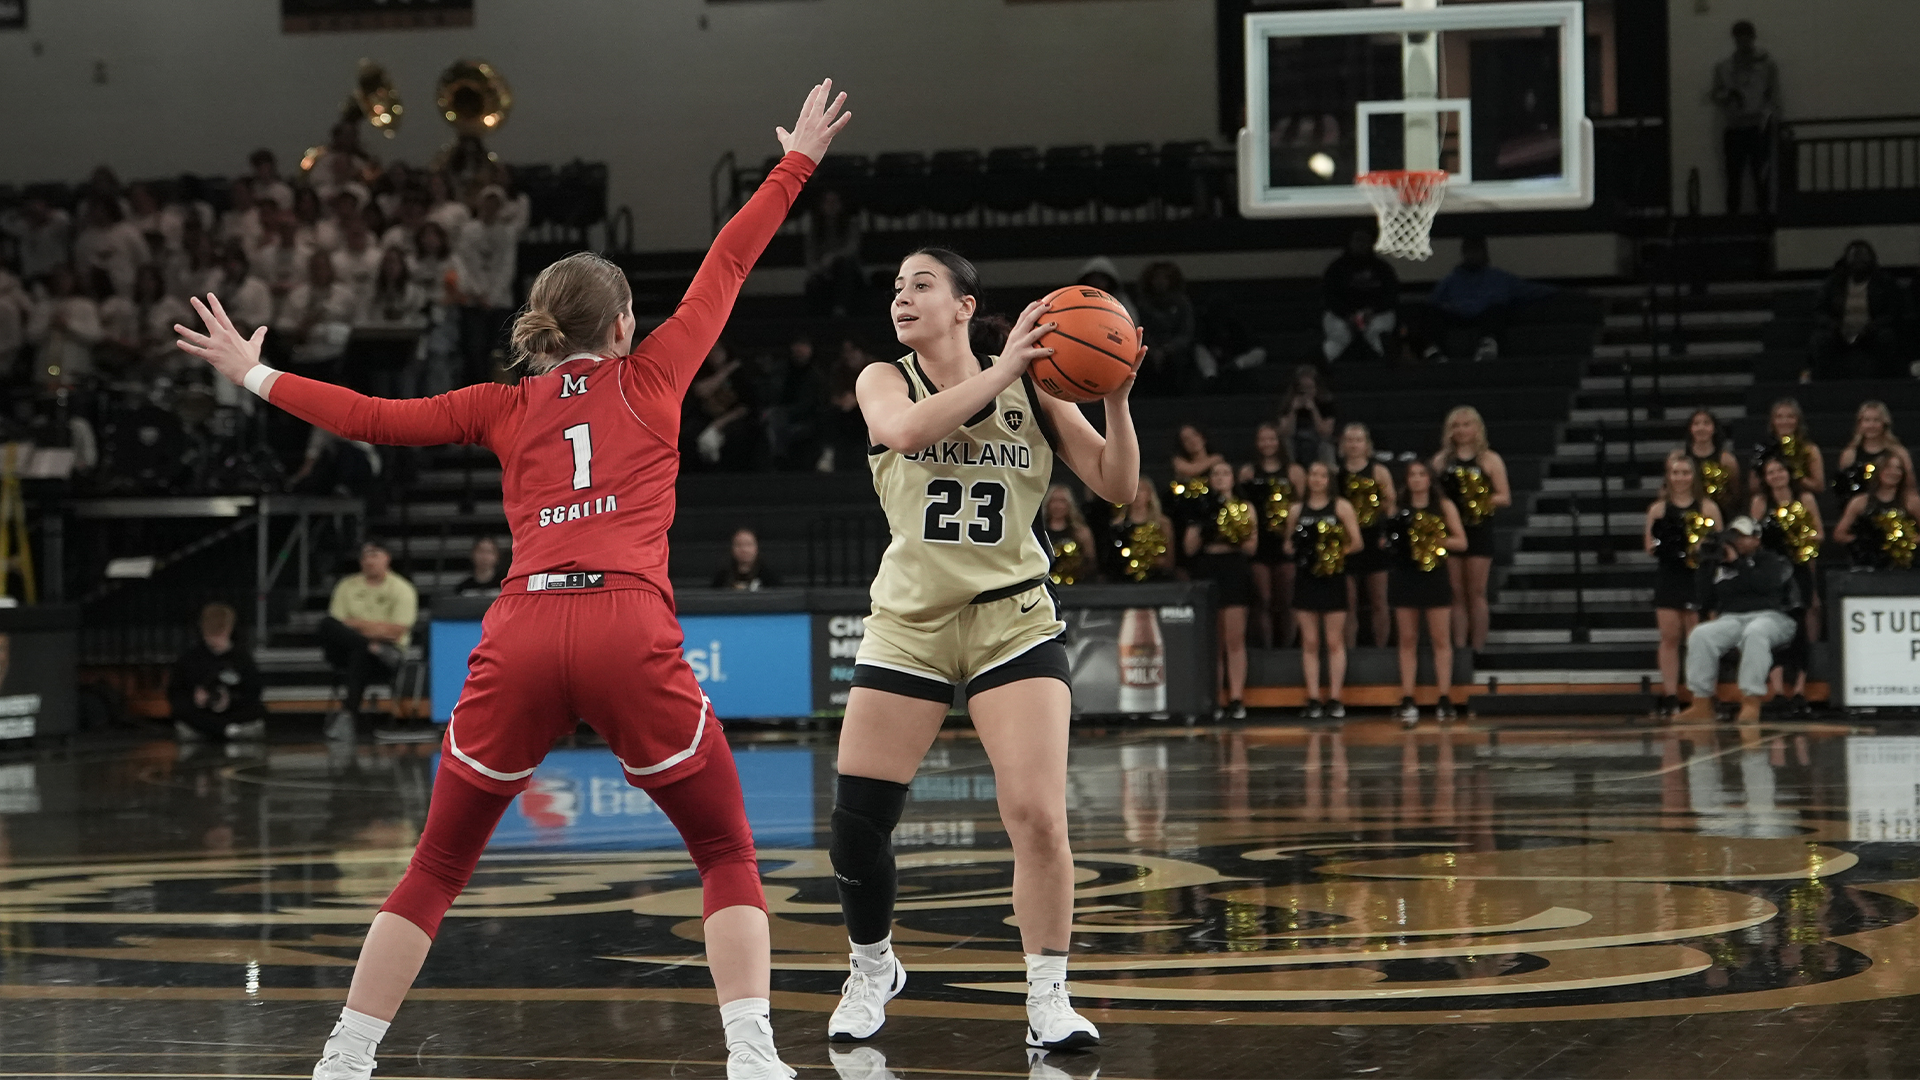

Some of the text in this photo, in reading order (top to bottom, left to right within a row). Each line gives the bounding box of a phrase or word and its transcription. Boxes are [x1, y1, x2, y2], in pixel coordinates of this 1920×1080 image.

[559, 373, 589, 398] M
[562, 422, 593, 491] 1
[921, 476, 1009, 547] 23
